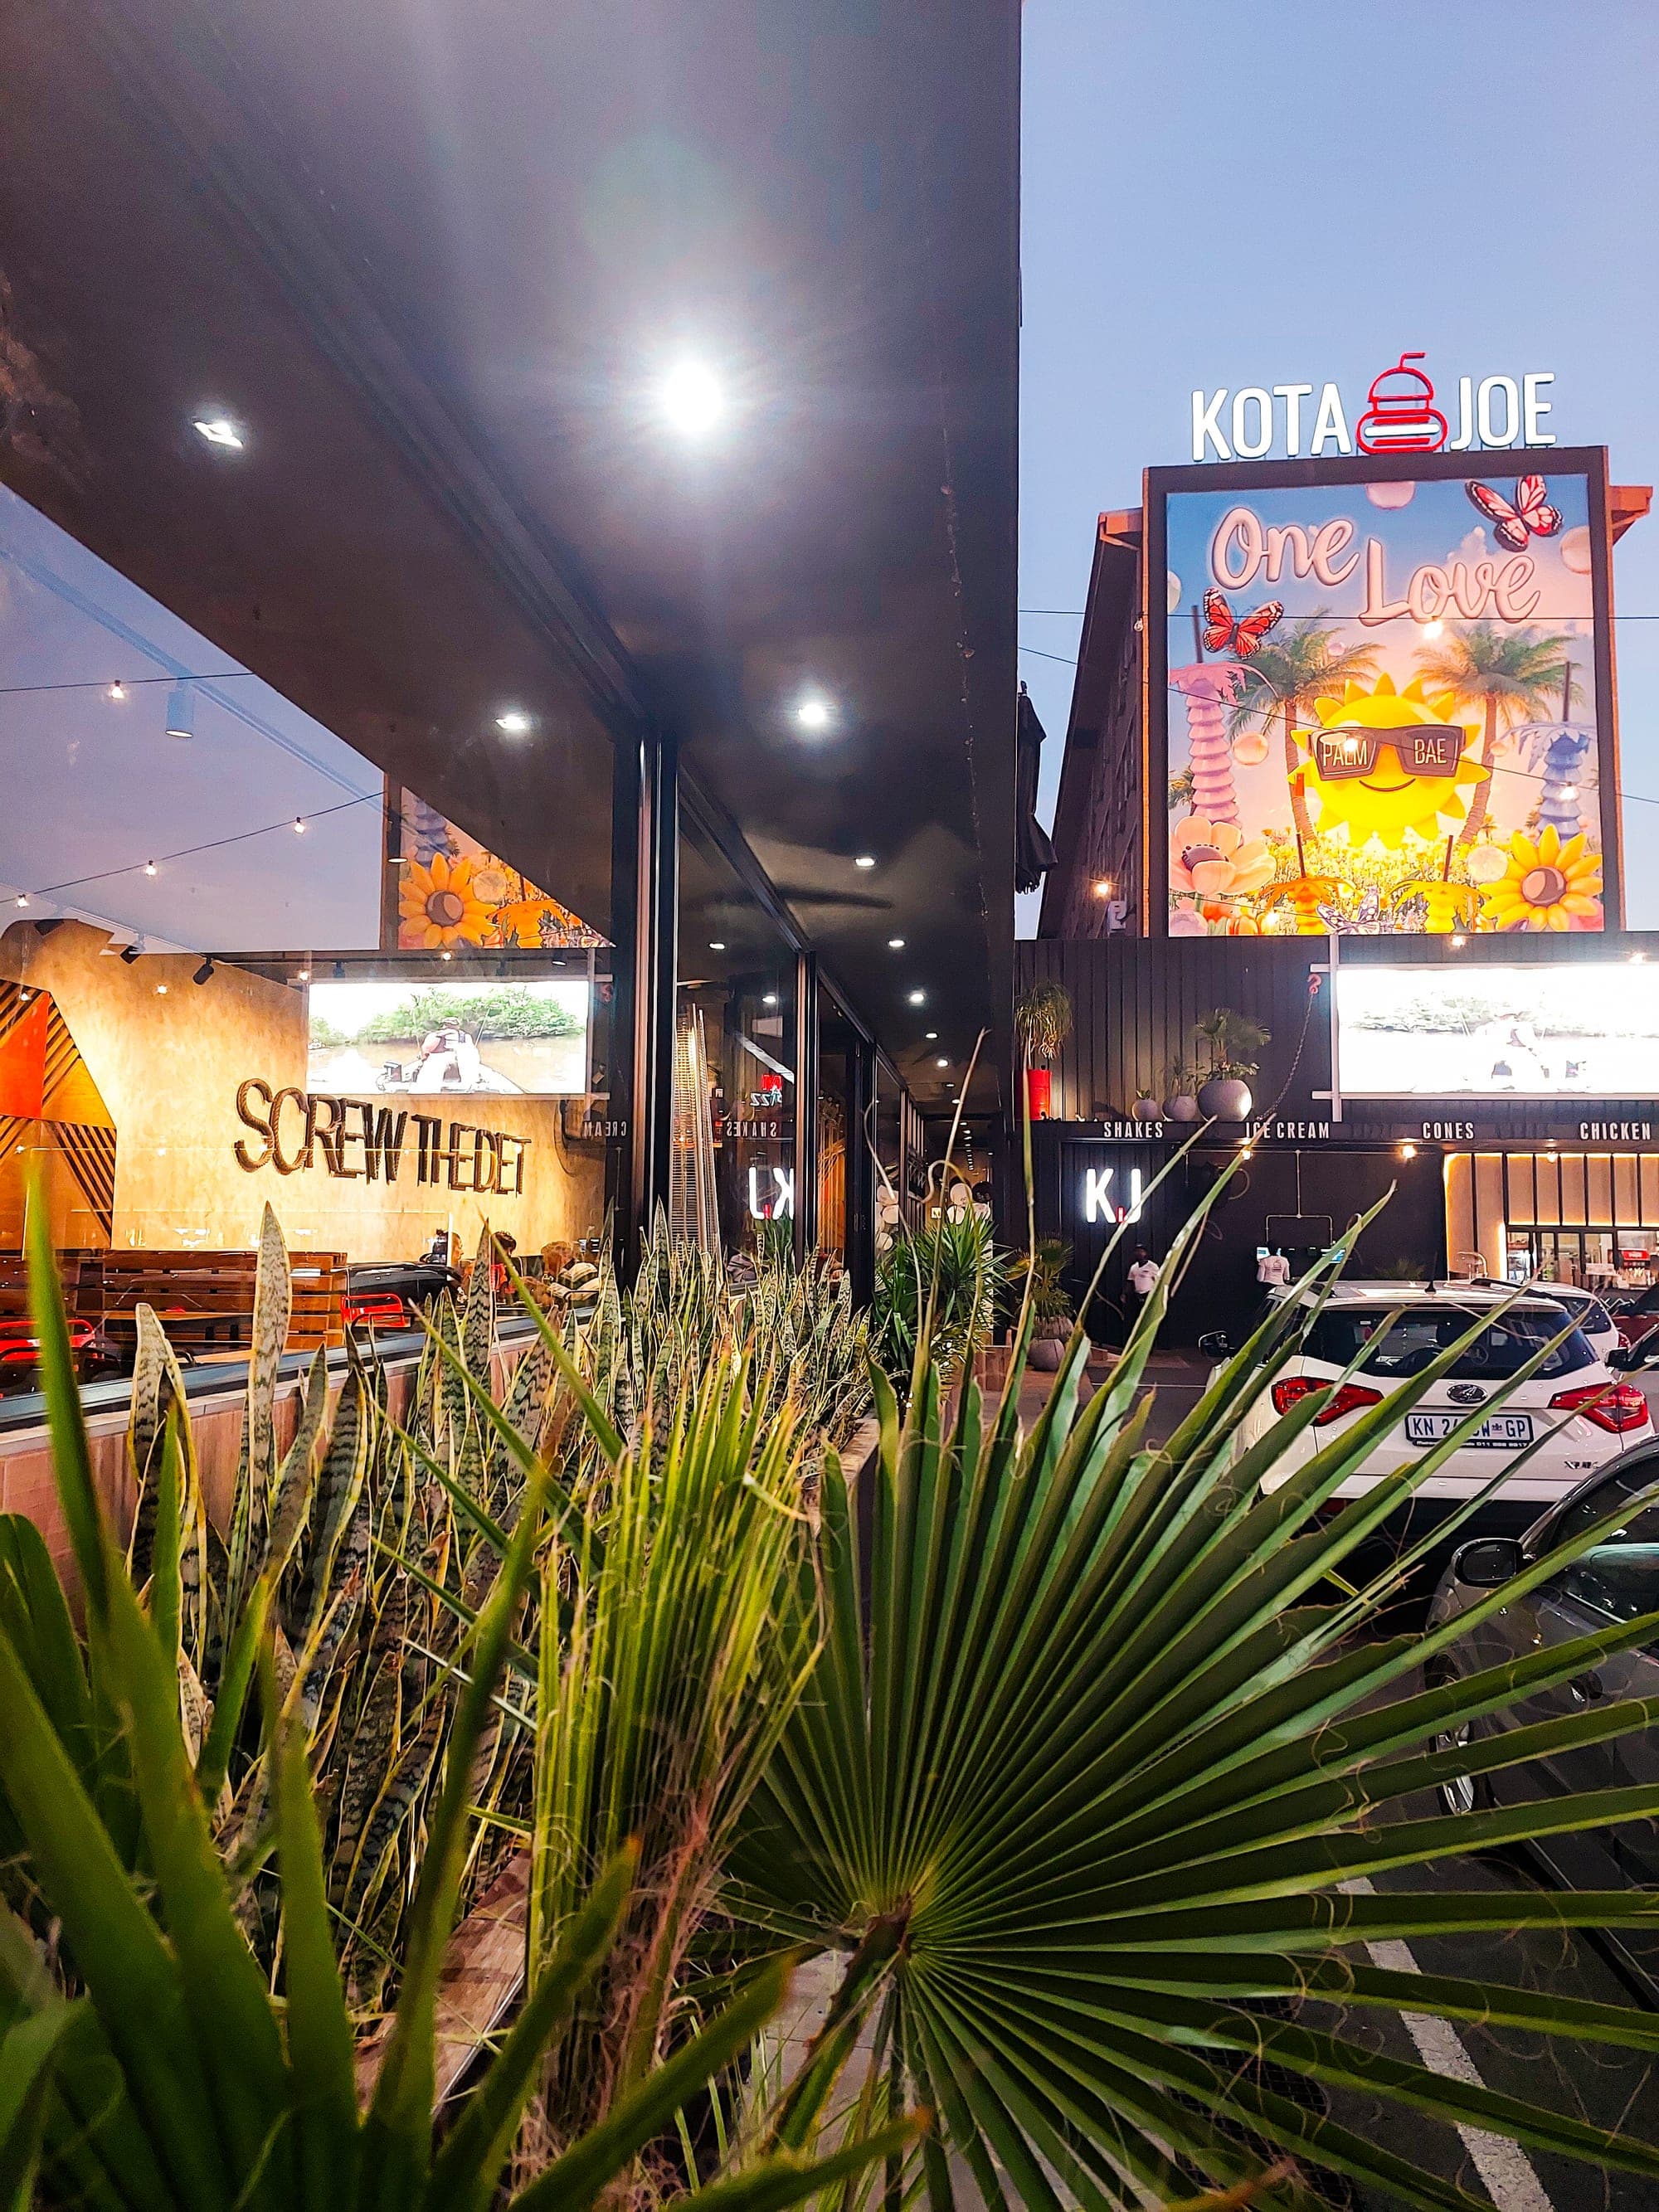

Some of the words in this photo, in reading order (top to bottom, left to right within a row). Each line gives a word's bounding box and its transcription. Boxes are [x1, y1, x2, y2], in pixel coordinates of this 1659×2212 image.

[1191, 382, 1352, 461] KOTA
[1450, 372, 1557, 450] JOE
[1212, 507, 1360, 590] One
[1358, 538, 1540, 627] Love
[1322, 739, 1367, 766] PALM
[1414, 737, 1447, 765] BAE
[233, 1077, 408, 1186] SCREW
[411, 1114, 476, 1191] THE
[1103, 1121, 1163, 1139] SHAKES
[1246, 1121, 1271, 1139] ICE
[1277, 1121, 1330, 1139] CREAM
[1422, 1121, 1474, 1140] CONES
[1579, 1122, 1651, 1140] CHICKEN
[1087, 1168, 1142, 1223] KJ
[1413, 1417, 1433, 1436] KN
[1506, 1419, 1525, 1437] GP
